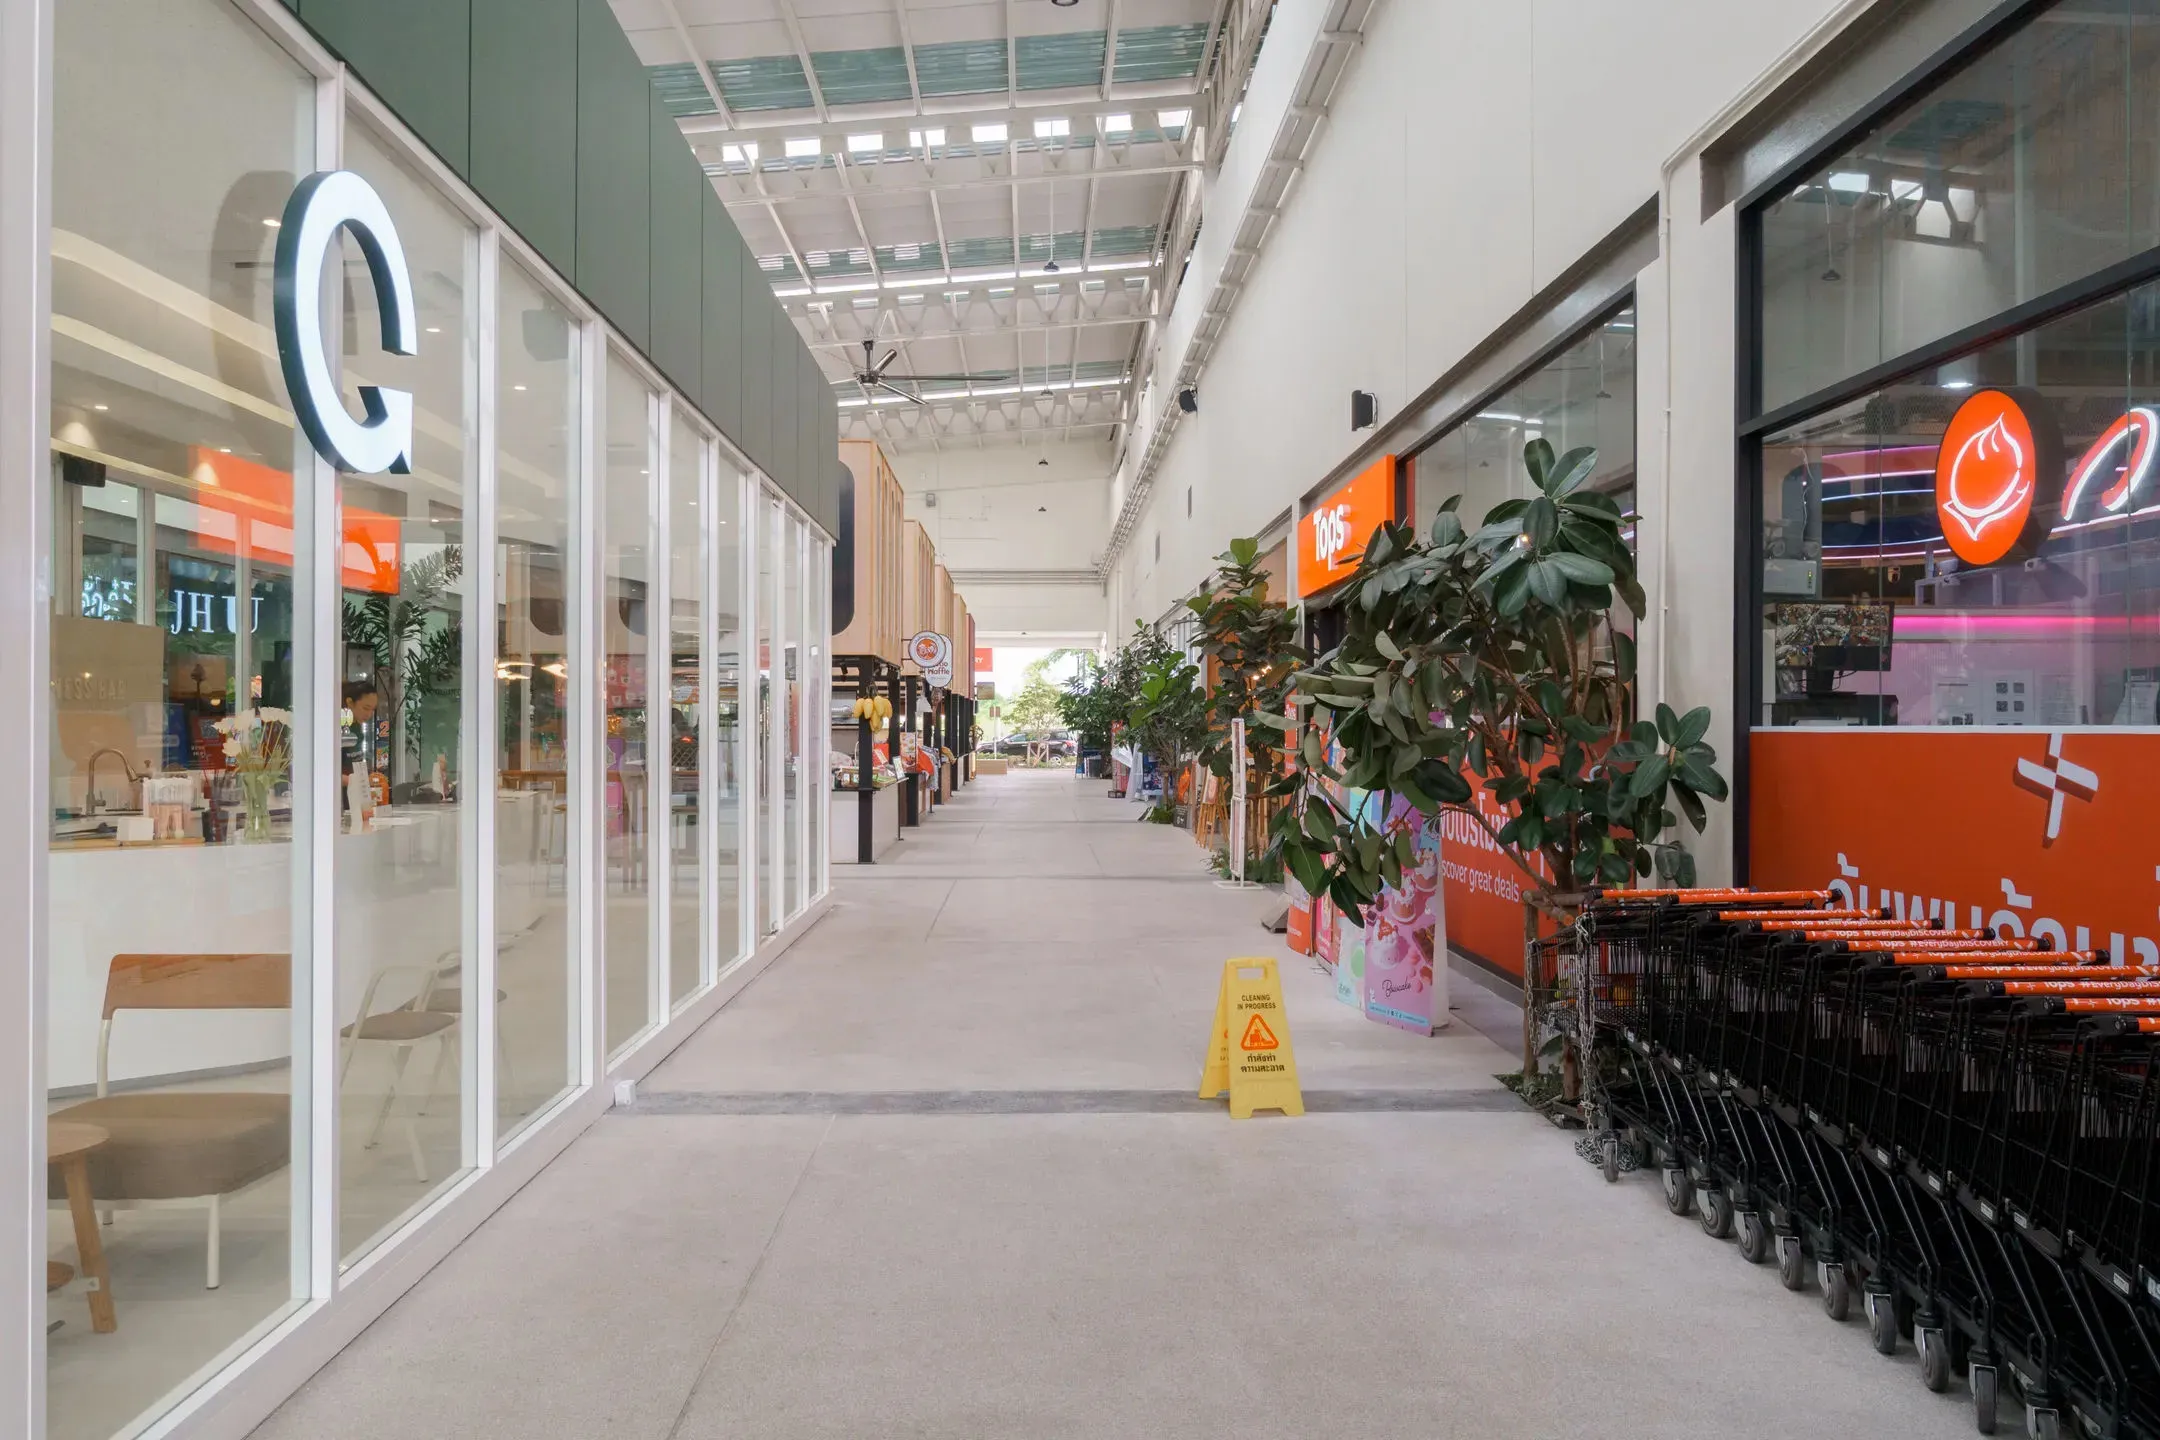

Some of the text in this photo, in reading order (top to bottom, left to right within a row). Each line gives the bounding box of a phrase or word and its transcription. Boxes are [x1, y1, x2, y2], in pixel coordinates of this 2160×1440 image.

[1312, 504, 1348, 572] Tops
[1441, 859, 1520, 903] scover great deals
[1241, 994, 1271, 1002] CLEANING
[1244, 1002, 1277, 1010] PROGRESS
[1246, 1053, 1276, 1063] กำลังทำ
[1240, 1064, 1285, 1073] ความสะอาด
